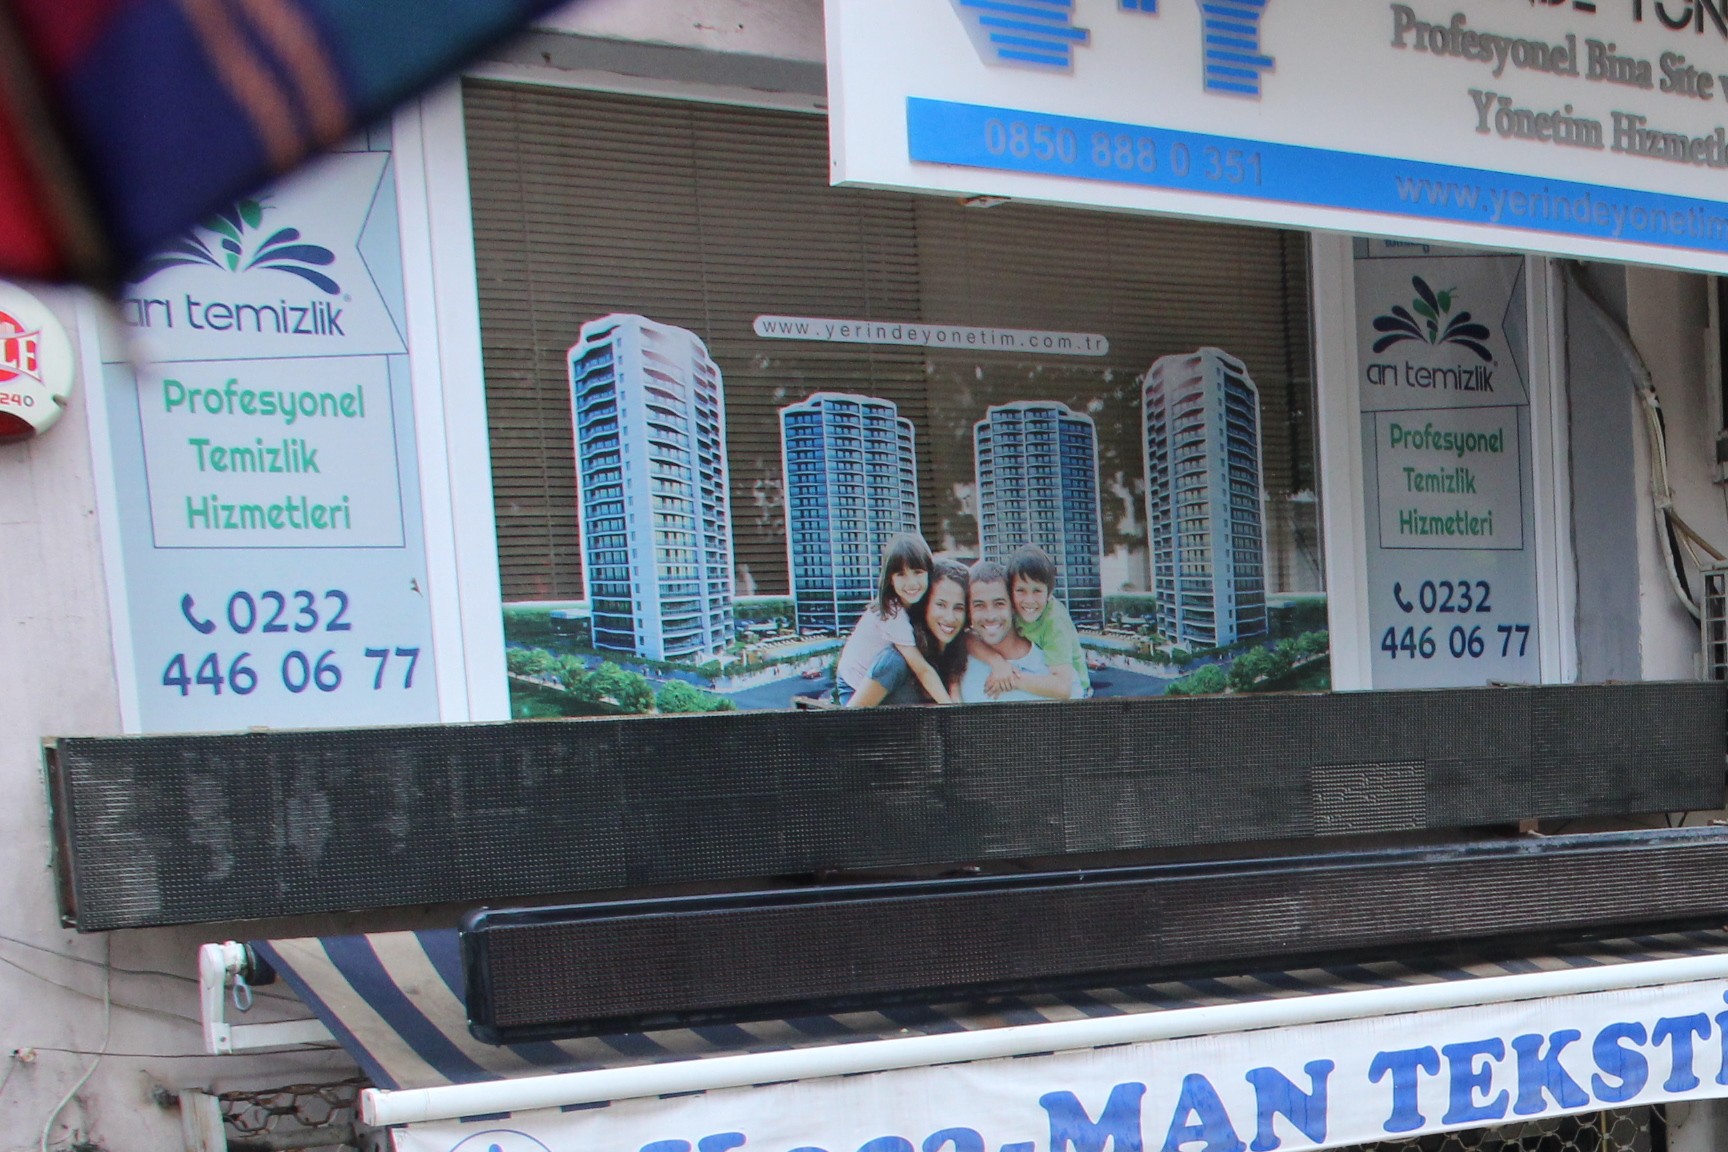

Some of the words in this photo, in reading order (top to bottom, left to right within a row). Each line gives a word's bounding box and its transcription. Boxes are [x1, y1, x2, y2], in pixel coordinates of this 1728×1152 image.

[1390, 3, 1580, 77] Profesyonel
[1585, 38, 1653, 90] Bina
[1659, 51, 1714, 101] Site
[1467, 88, 1605, 150] Yönetim
[984, 118, 1078, 164] 0850
[1091, 132, 1157, 174] 888
[1170, 142, 1190, 178] 0
[1203, 146, 1263, 187] 351
[186, 293, 345, 337] temizlik
[762, 318, 1102, 352] www.yerindeyonetim.com.tr
[1404, 362, 1493, 393] temizlik
[163, 378, 366, 425] Profesyonel
[189, 437, 321, 474] Temizlik
[1390, 424, 1504, 458] Profesyonel
[1403, 466, 1477, 495] Temizlik
[186, 494, 351, 530] Hizmetleri
[1400, 509, 1493, 538] Hizmetleri
[227, 590, 352, 634] 0232
[1419, 580, 1492, 614] 0232
[1380, 626, 1437, 660] 446
[1448, 626, 1485, 658] 06
[1497, 624, 1531, 658] 77
[162, 652, 258, 697] 446
[282, 649, 342, 692] 06
[365, 647, 422, 691] 77
